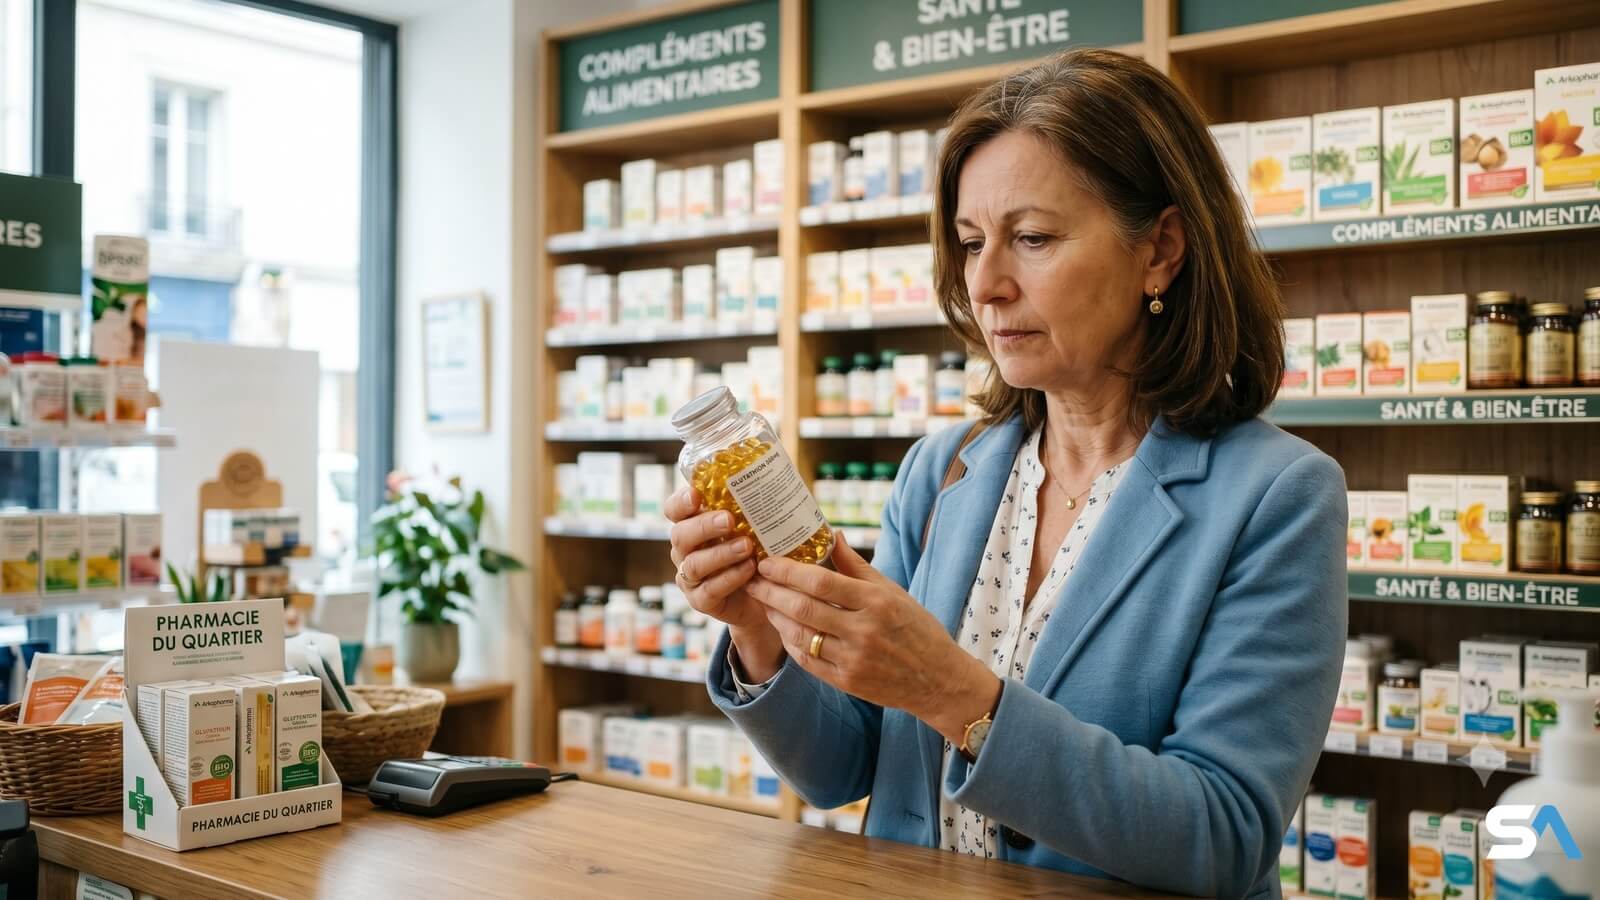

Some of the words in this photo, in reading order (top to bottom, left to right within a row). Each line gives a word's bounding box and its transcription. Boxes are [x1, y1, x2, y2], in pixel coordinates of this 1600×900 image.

[578, 21, 767, 82] COMPLÉMENTS
[873, 40, 896, 71] &
[902, 9, 1070, 67] BIEN-ÊTRE
[582, 59, 761, 116] ALIMENTAIRES
[1511, 132, 1531, 146] BIO
[1332, 213, 1487, 242] COMPLÉMENTS
[1380, 398, 1447, 420] SANTÉ
[1452, 401, 1467, 419] &
[1472, 395, 1587, 419] BIEN-ÊTRE
[1375, 576, 1442, 599] SANTÉ
[1446, 581, 1460, 599] &
[1466, 581, 1579, 606] BIEN-ÊTRE
[157, 610, 259, 631] PHARMACIE
[152, 635, 176, 652] DU
[182, 629, 263, 650] QUARTIER
[214, 762, 230, 771] BIO
[192, 811, 260, 832] PHARMACIE
[263, 808, 278, 820] DU
[281, 799, 333, 817] QUARTIER
